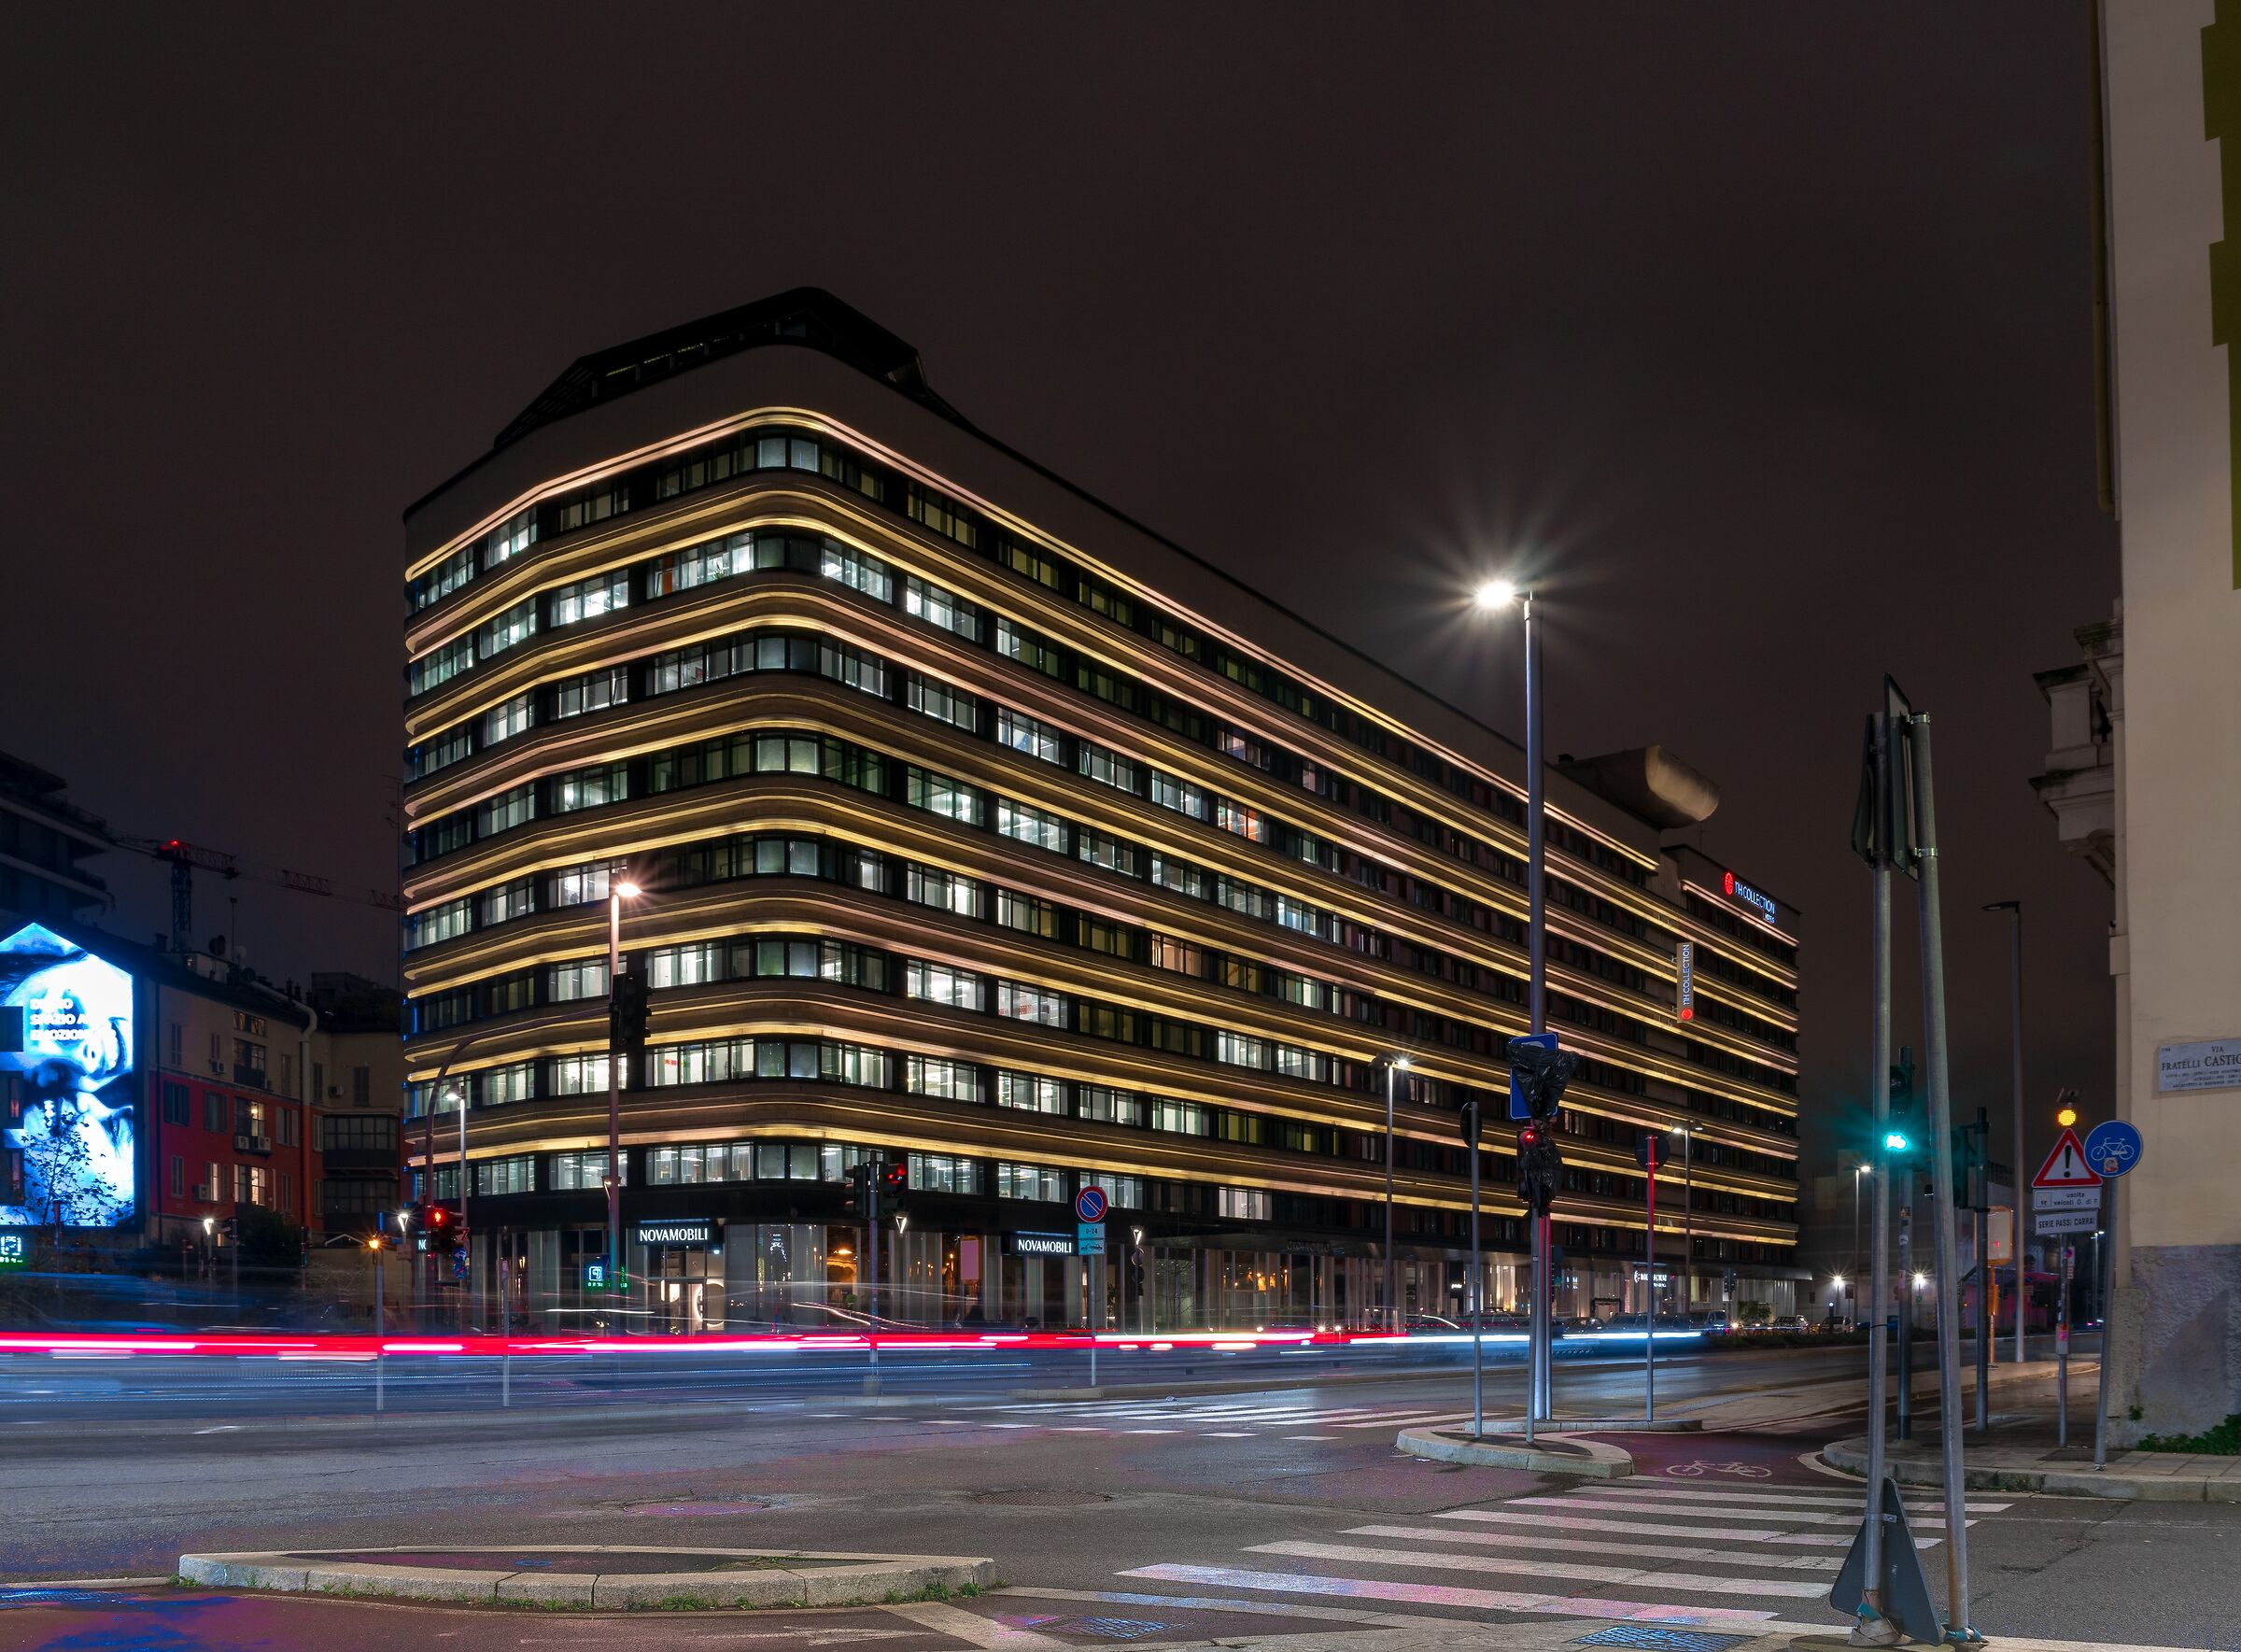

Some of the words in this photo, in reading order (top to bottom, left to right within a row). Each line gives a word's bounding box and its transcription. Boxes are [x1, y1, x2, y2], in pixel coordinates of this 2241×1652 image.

[1743, 886, 1775, 914] COLLECTION
[2162, 1060, 2200, 1071] FRATELLI
[2038, 1220, 2054, 1229] SERIE
[640, 1228, 708, 1241] NOVAMOBILI
[1019, 1239, 1072, 1252] NOVAMOBILI
